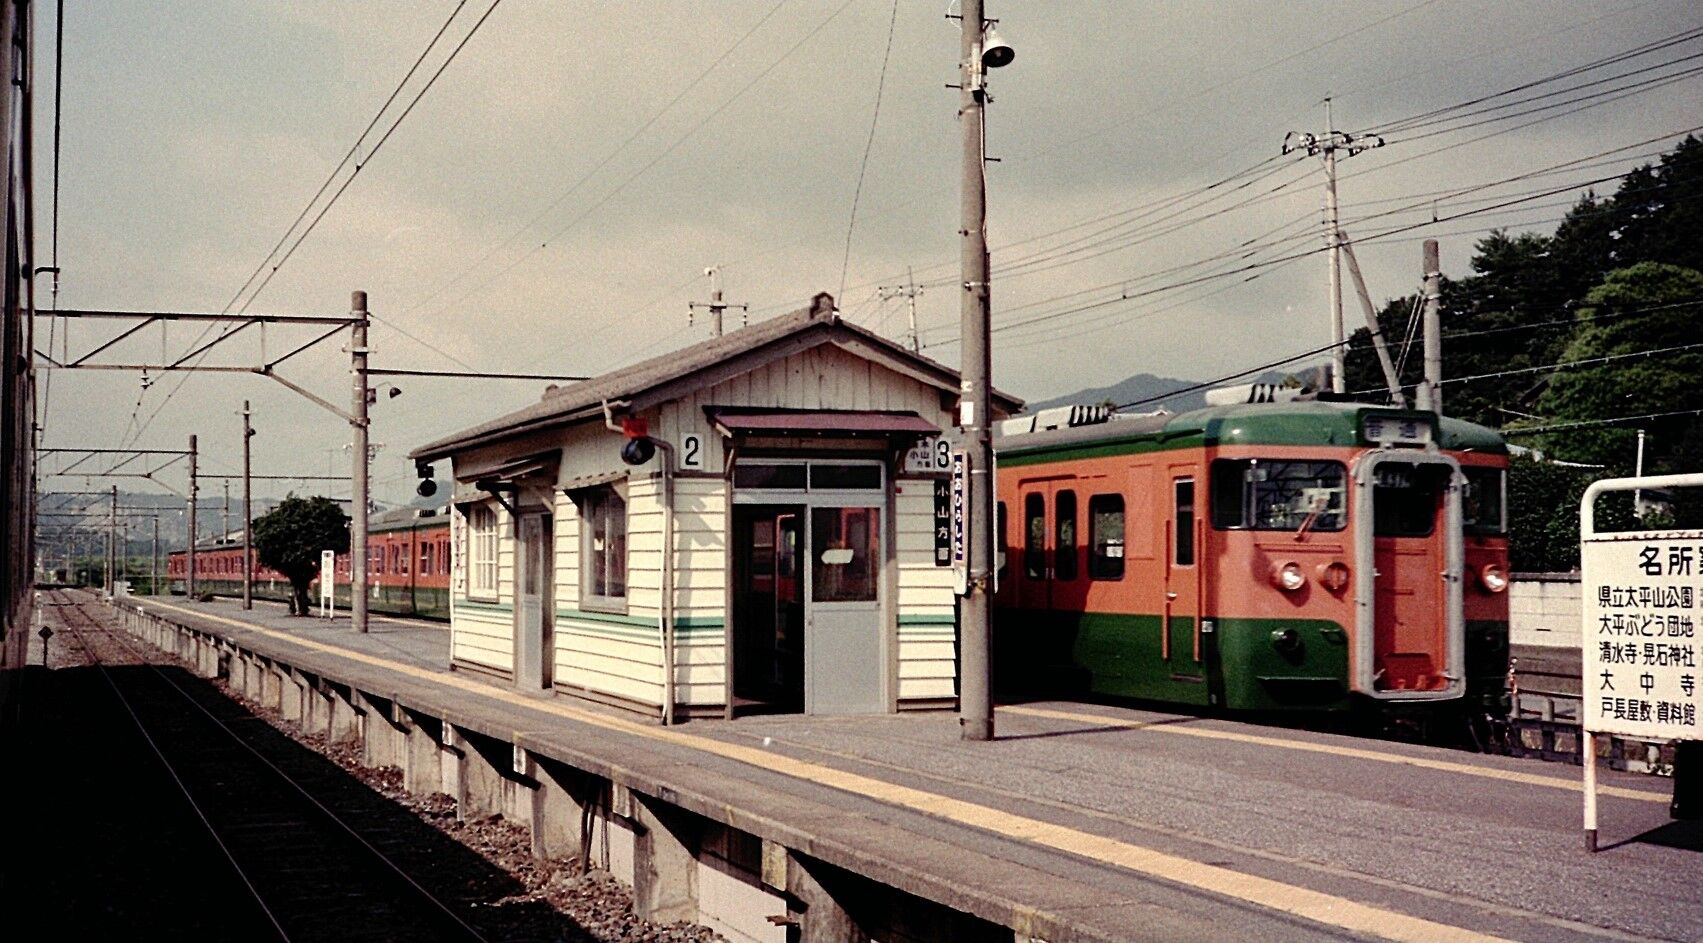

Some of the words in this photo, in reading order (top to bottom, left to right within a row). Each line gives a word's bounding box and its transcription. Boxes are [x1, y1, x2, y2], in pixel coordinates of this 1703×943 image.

[685, 436, 699, 466] 2
[937, 441, 949, 468] 3
[1639, 546, 1703, 577] 名所
[1598, 586, 1693, 609] 県立太平山公園
[1599, 614, 1694, 638] 大平ぶどう団地
